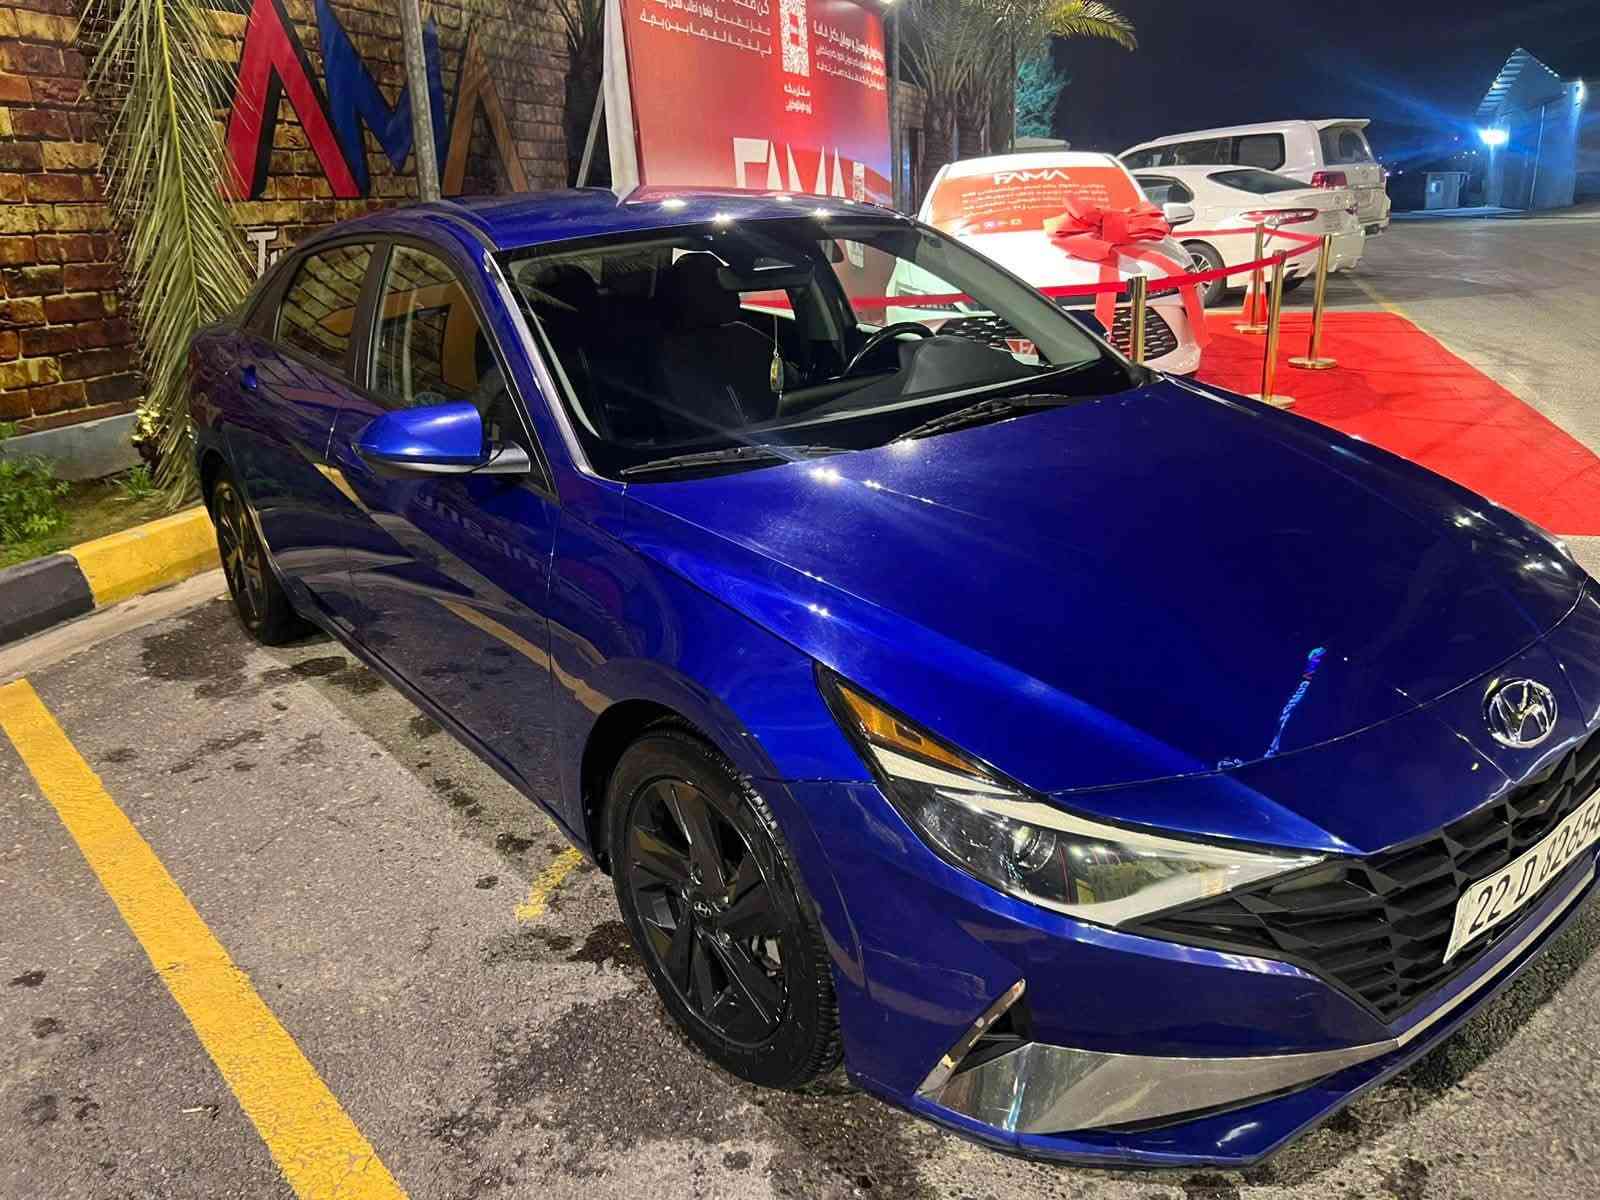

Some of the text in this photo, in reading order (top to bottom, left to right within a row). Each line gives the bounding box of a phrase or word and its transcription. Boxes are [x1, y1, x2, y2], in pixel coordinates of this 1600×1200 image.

[992, 168, 1070, 185] FAMA
[1468, 874, 1511, 934] 22
[1514, 854, 1538, 904] D
